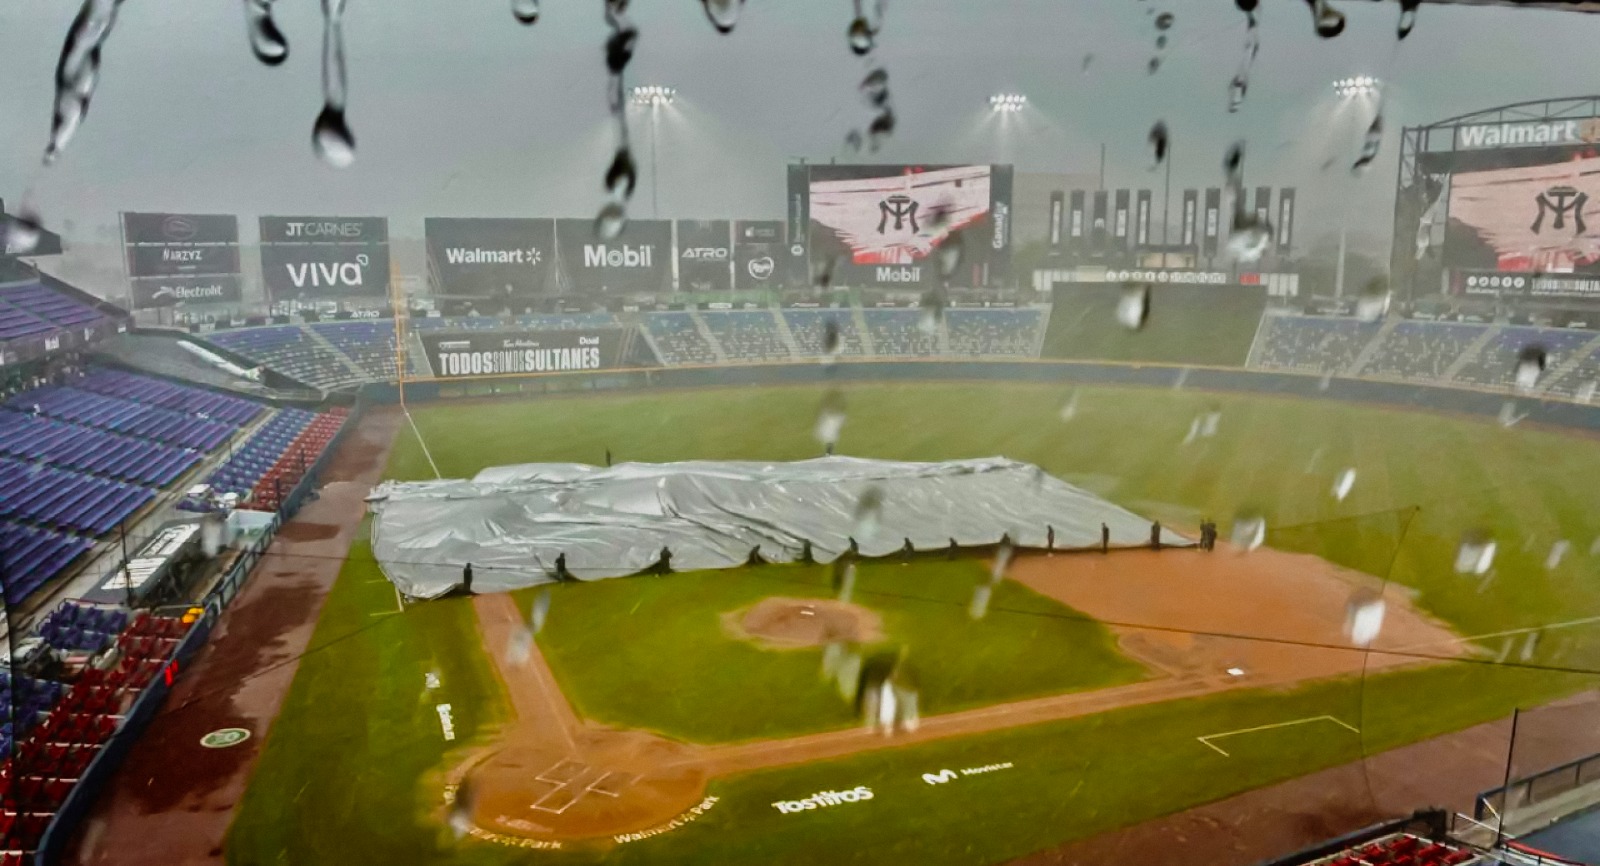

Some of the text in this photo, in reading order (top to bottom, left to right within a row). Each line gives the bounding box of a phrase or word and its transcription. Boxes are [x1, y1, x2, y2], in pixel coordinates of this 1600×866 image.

[1461, 121, 1576, 147] Walmart
[446, 247, 524, 264] Walmart
[584, 244, 652, 268] Mobil
[681, 247, 728, 258] ATRO
[876, 265, 921, 283] Mobil
[176, 284, 223, 298] Electrolit
